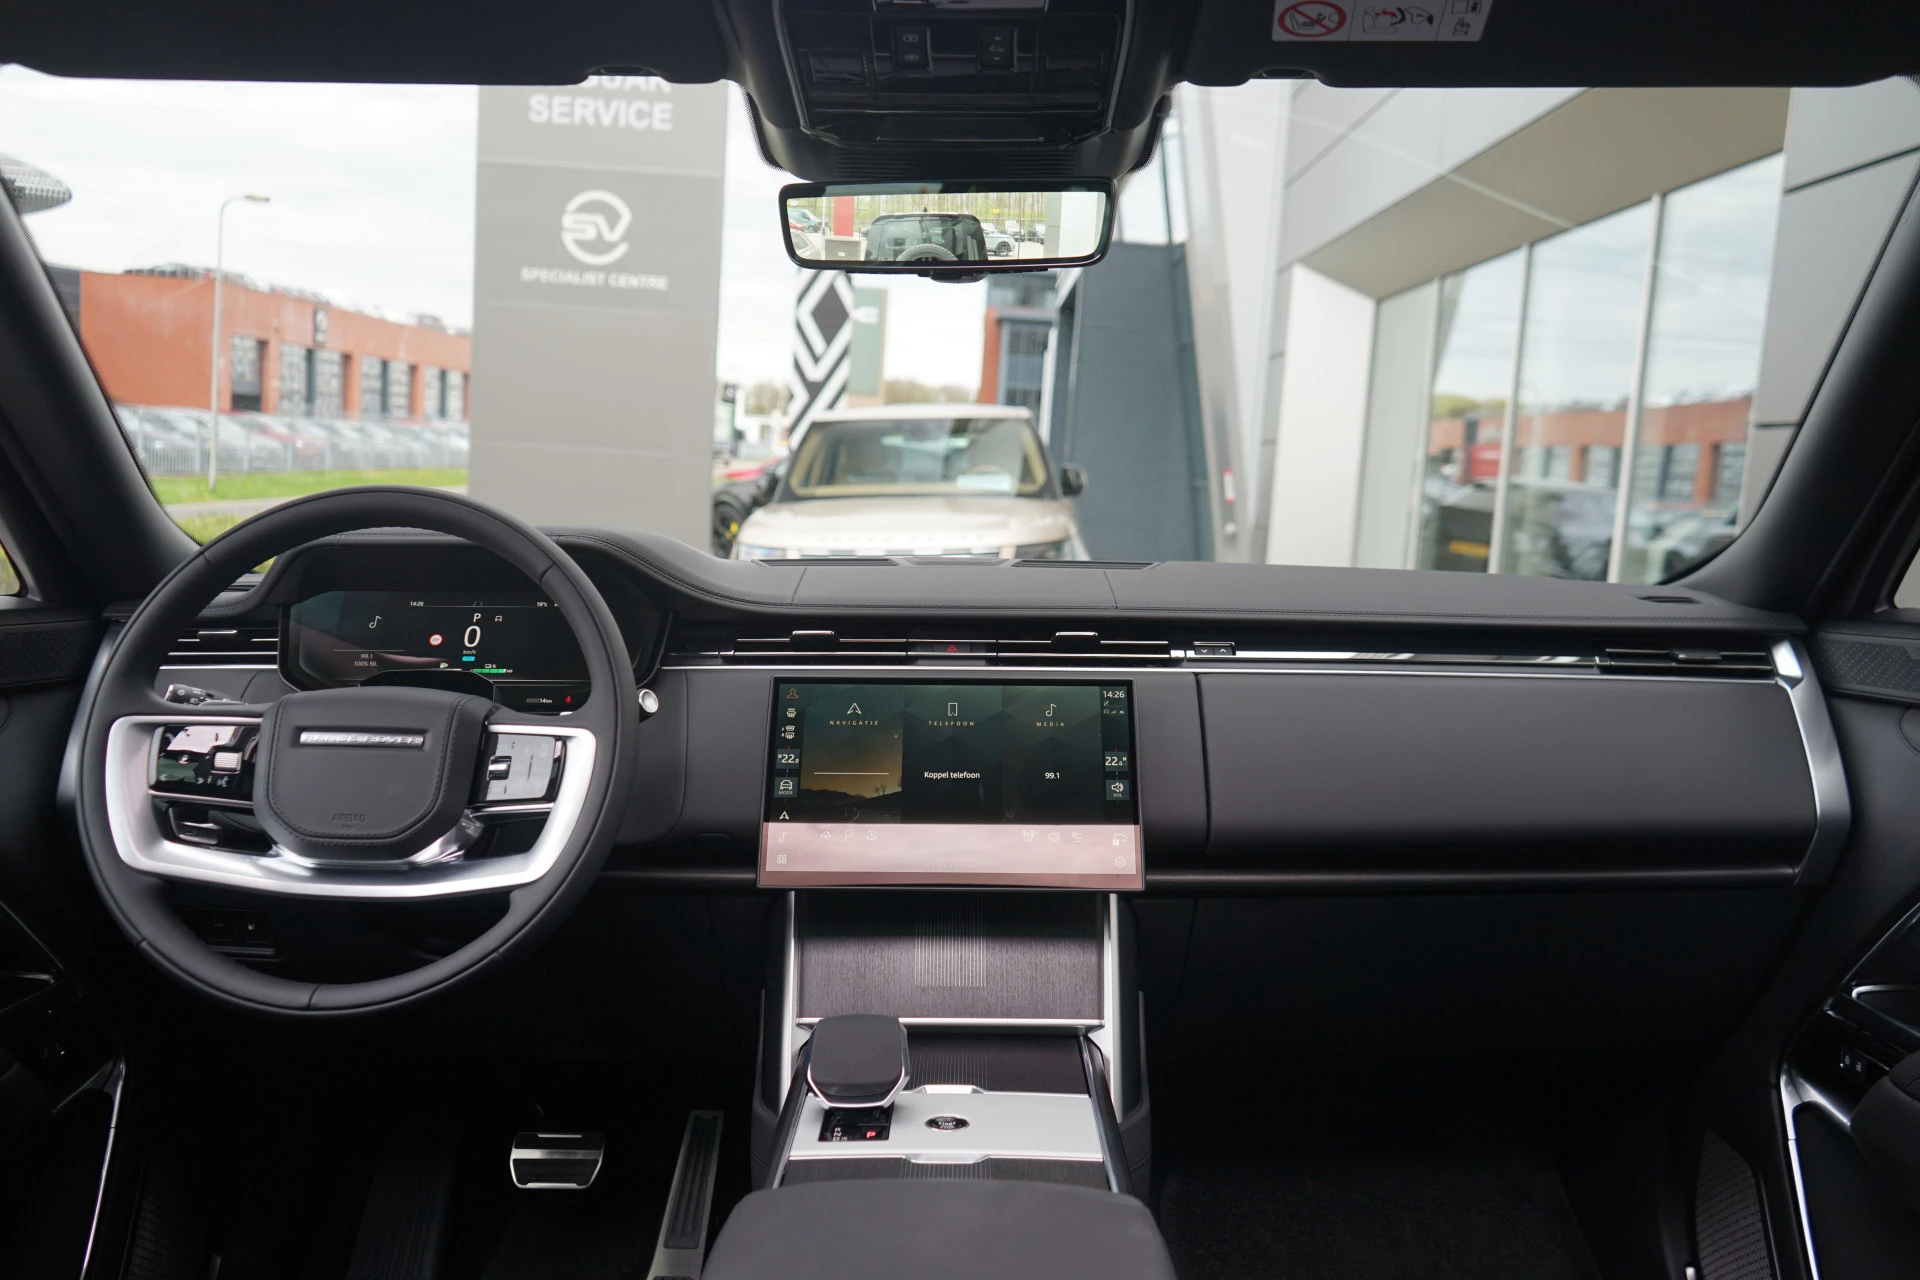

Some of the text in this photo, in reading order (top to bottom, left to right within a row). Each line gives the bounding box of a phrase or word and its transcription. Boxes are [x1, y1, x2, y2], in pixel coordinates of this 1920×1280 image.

[528, 93, 674, 131] SERVICE
[520, 267, 669, 291] SPECIALIST CENTRE
[473, 613, 482, 622] P
[464, 625, 481, 647] 0
[1102, 690, 1125, 699] 14:26
[924, 771, 981, 780] Koppel telefoon
